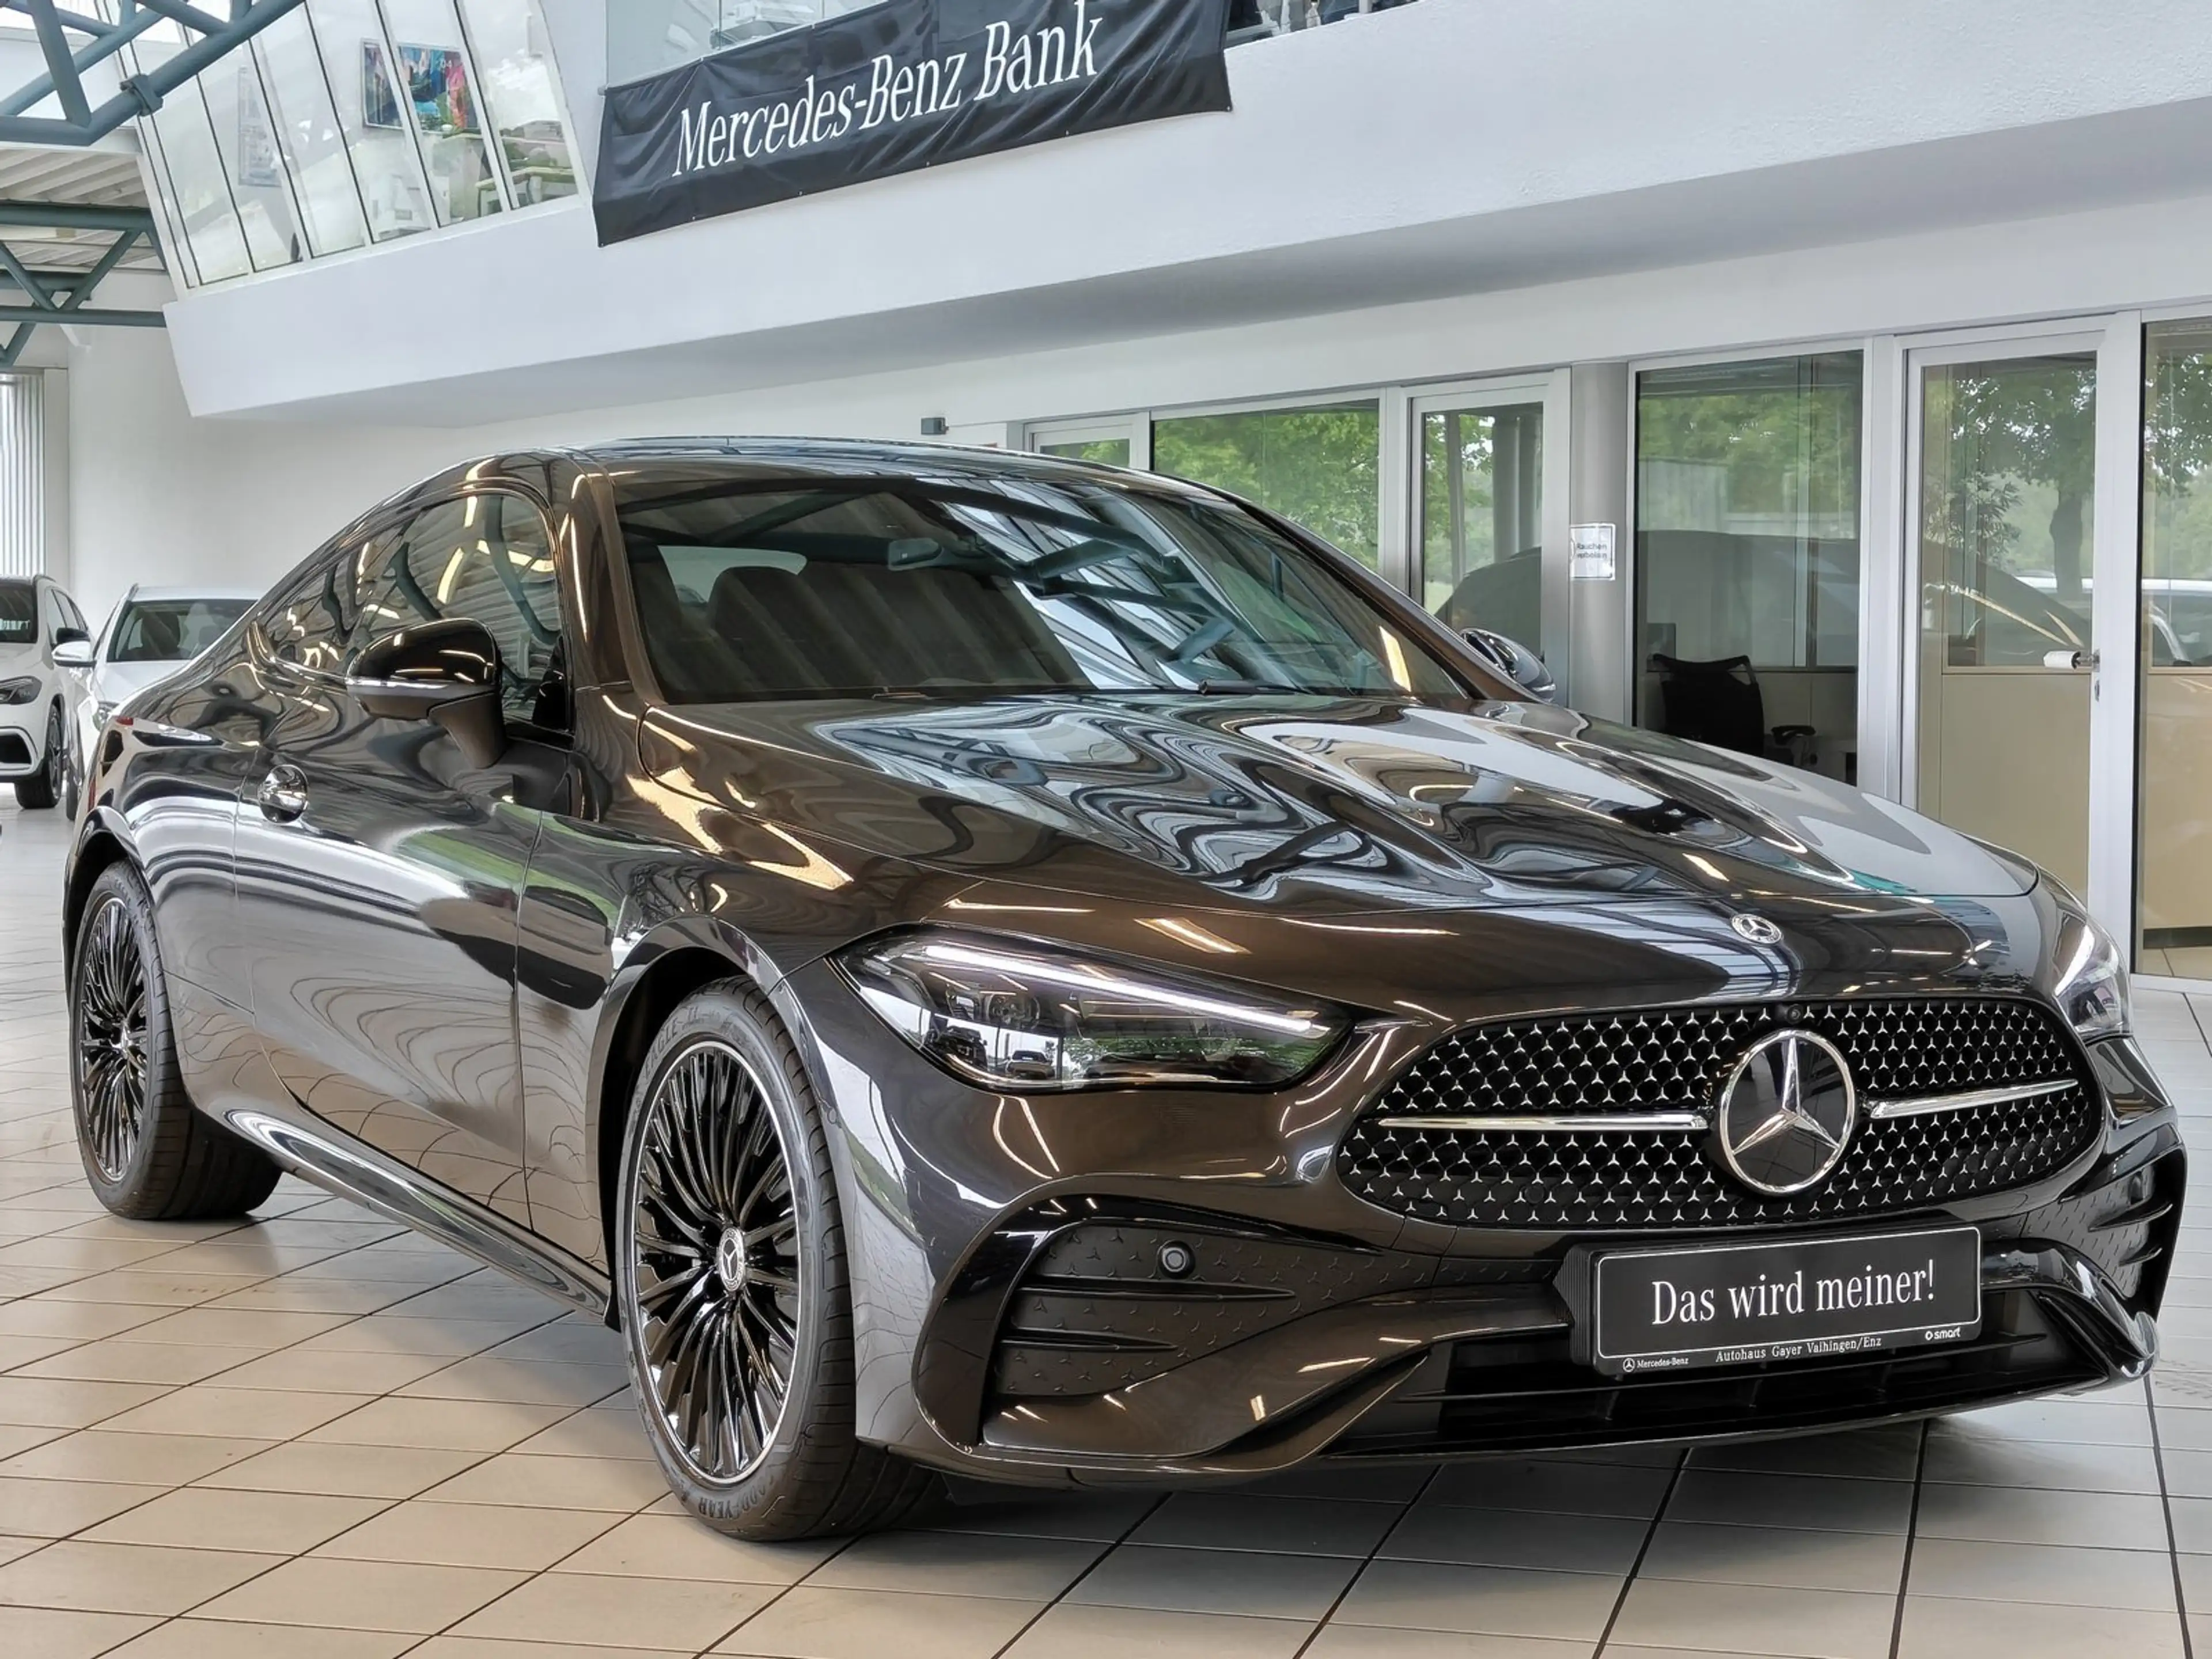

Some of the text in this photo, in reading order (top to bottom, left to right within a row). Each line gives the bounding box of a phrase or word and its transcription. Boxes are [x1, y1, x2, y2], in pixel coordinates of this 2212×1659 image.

[672, 0, 1106, 177] Mercedes-Benz Bank
[1652, 1259, 1933, 1325] Das wird meiner!
[1934, 1327, 1960, 1339] smart
[1716, 1349, 1766, 1362] Autohaus
[1772, 1344, 1802, 1358] Gayer
[1637, 1357, 1688, 1368] Mercedes-Benz
